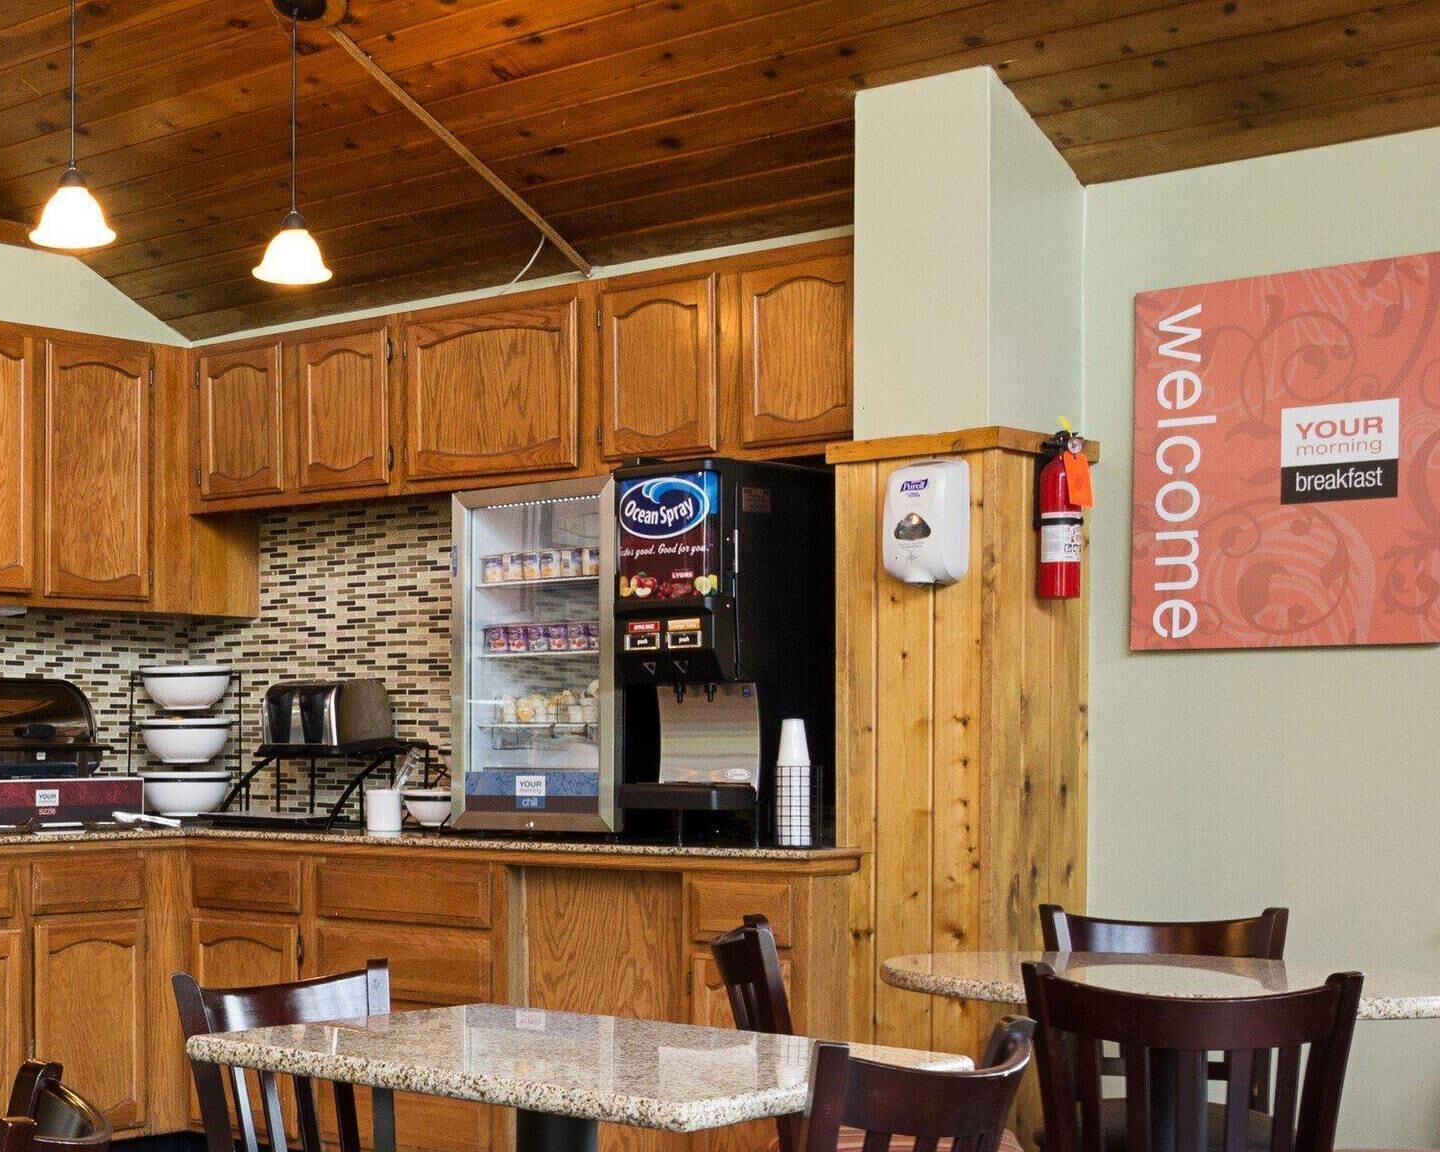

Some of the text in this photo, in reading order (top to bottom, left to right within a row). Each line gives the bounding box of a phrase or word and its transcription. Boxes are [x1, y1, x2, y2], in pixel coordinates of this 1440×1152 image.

[1295, 416, 1384, 440] YOUR
[1296, 438, 1383, 457] morning
[1152, 303, 1217, 639] welcome
[1295, 466, 1384, 492] breakfast
[624, 498, 694, 527] Ocean Spray
[634, 544, 656, 560] good.
[657, 542, 678, 554] Good
[678, 542, 690, 555] for
[519, 780, 542, 788] YOUR
[522, 797, 538, 807] chill
